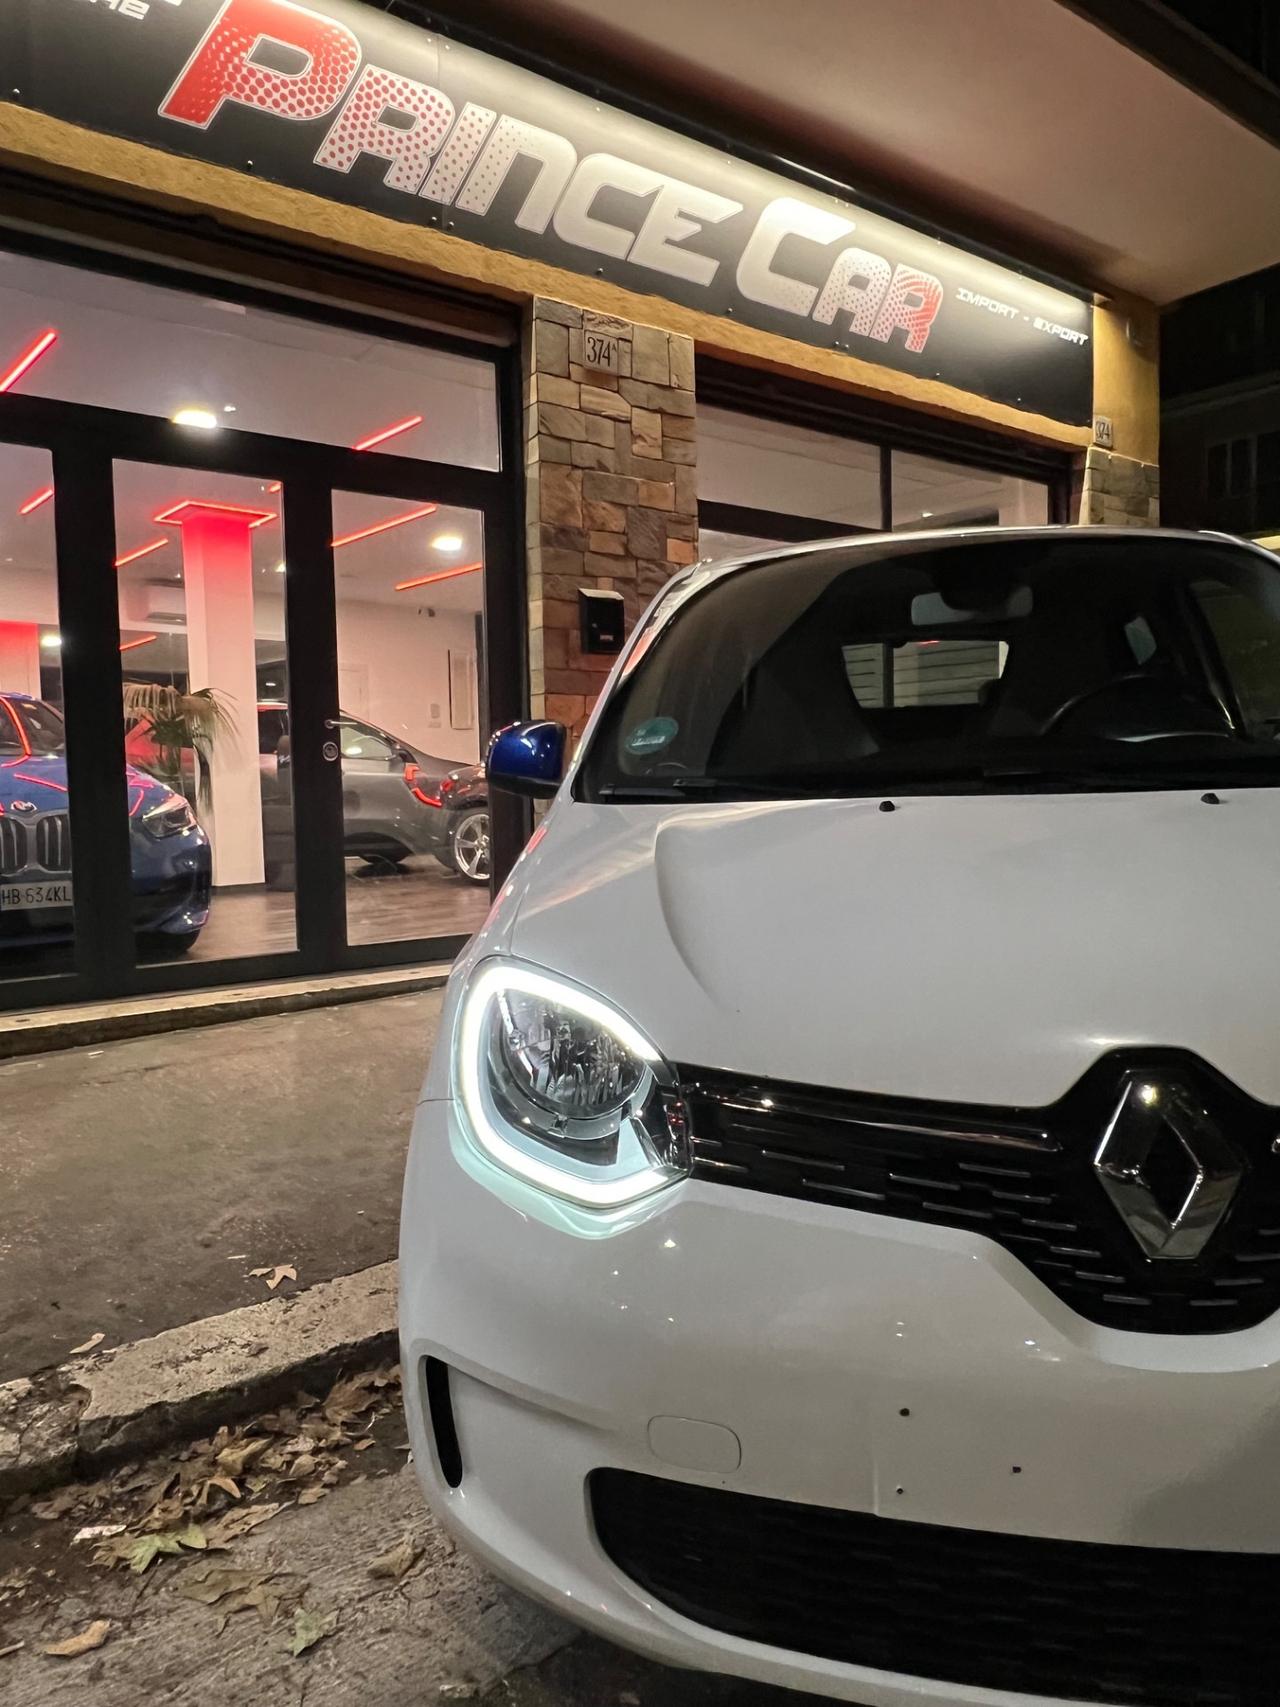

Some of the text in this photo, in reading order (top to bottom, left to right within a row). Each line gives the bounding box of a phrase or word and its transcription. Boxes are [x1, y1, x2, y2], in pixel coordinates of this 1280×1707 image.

[735, 197, 943, 354] CAR
[955, 287, 1020, 320] IMPORT
[1033, 316, 1089, 345] EXPORT
